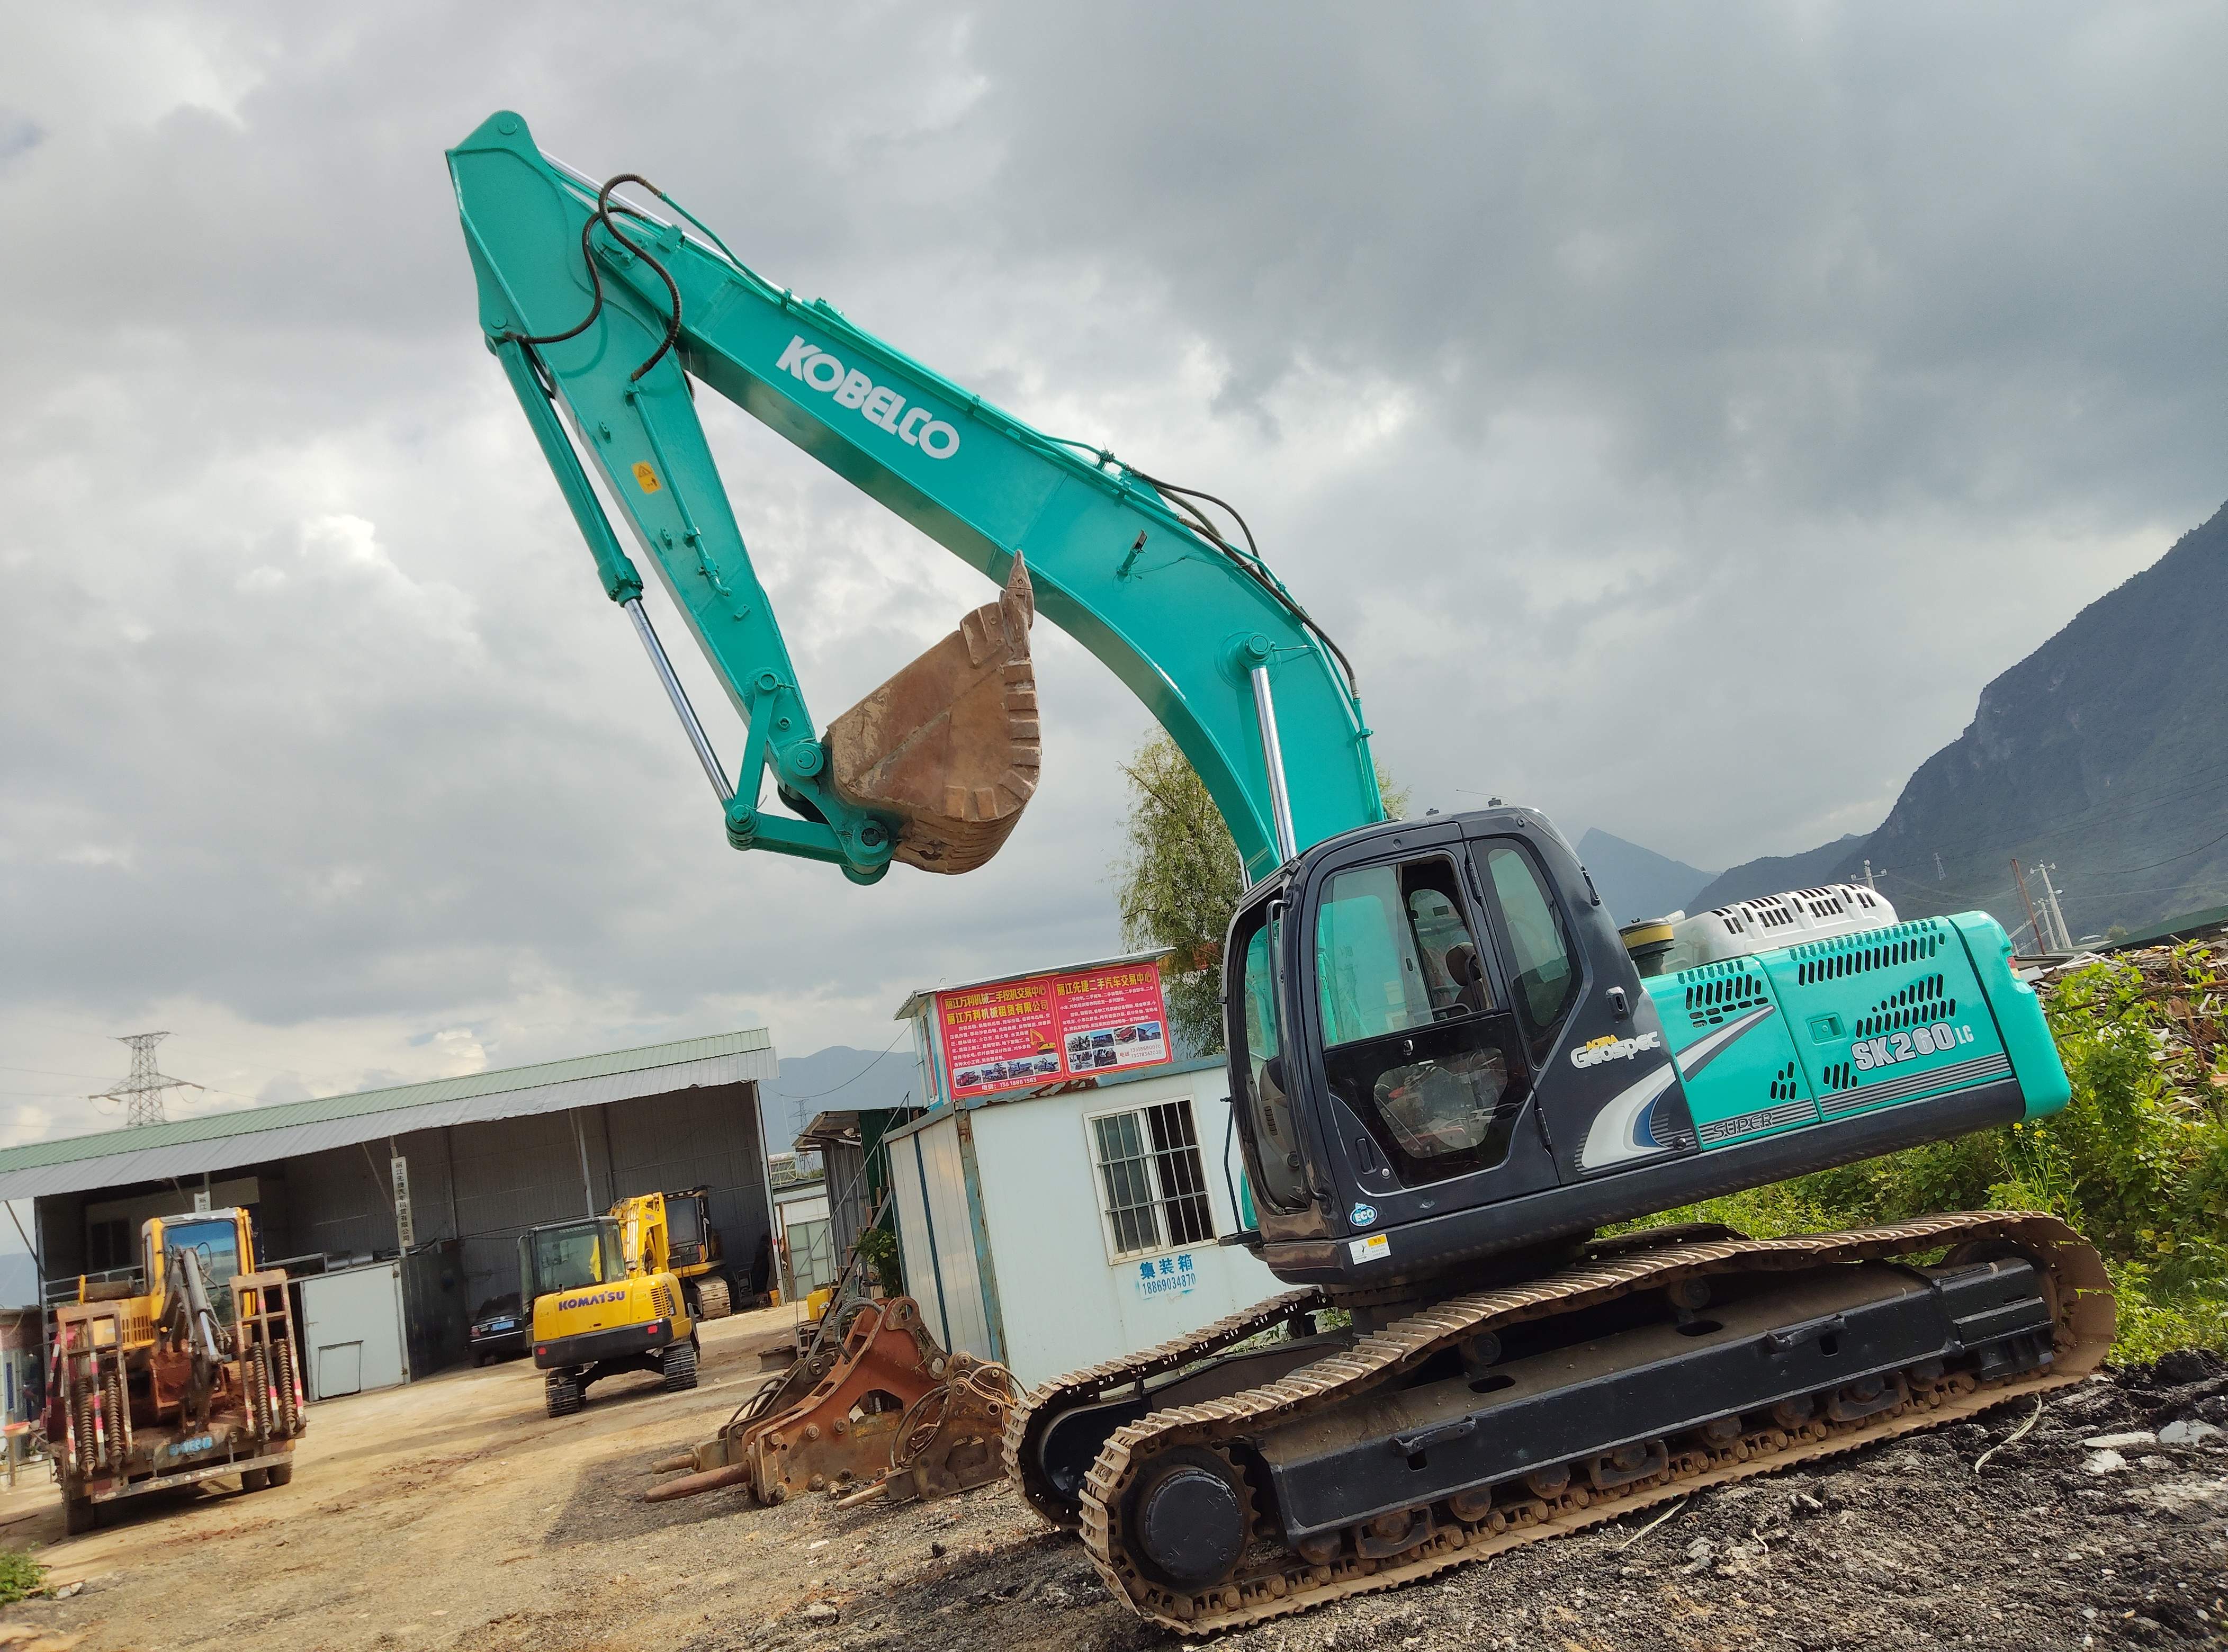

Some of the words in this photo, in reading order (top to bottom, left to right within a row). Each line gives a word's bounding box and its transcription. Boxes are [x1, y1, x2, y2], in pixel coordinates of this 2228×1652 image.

[775, 335, 960, 459] KOBELCO
[945, 984, 1046, 1010] 丽江万利机械二手挖机交易中心
[1056, 972, 1152, 996] 丽江先捷二手汽车交易中心
[947, 999, 1048, 1025] 丽江万利机械租赁有限公司
[1586, 1034, 1619, 1052] ACERA
[1851, 1022, 1956, 1071] SK260
[1955, 1025, 1974, 1045] LC
[1713, 1112, 1772, 1139] SUPER
[1354, 1209, 1374, 1222] ECO
[1139, 1254, 1193, 1280] 集装箱
[1142, 1273, 1196, 1296] 18869034870
[559, 1290, 625, 1312] KOMATSU
